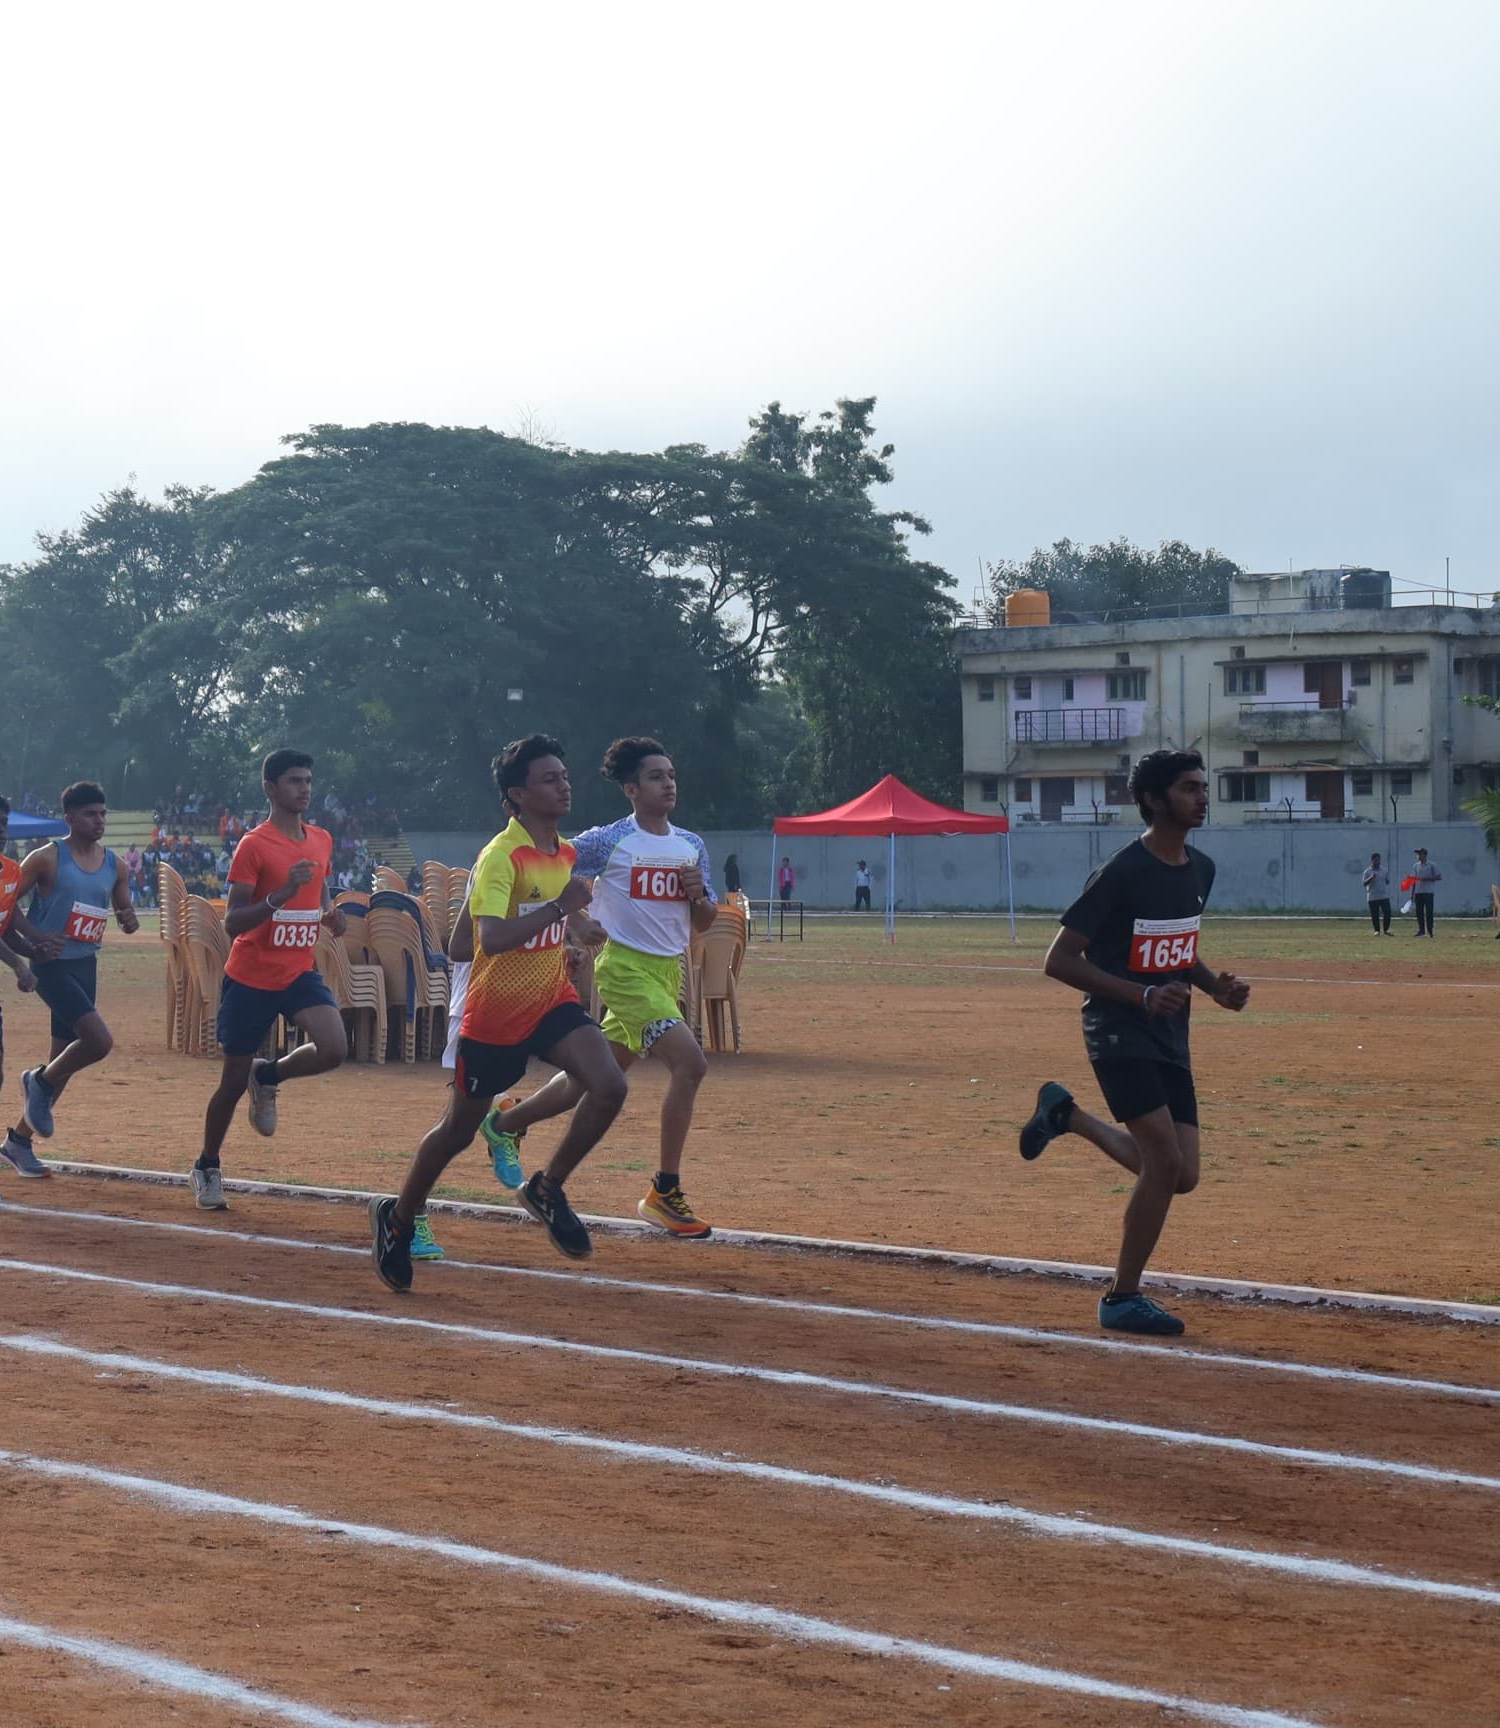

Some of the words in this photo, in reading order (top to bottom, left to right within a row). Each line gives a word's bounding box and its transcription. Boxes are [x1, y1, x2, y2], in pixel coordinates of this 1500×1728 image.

[637, 871, 684, 897] 160
[273, 924, 318, 947] 0335
[1139, 935, 1196, 968] 1654
